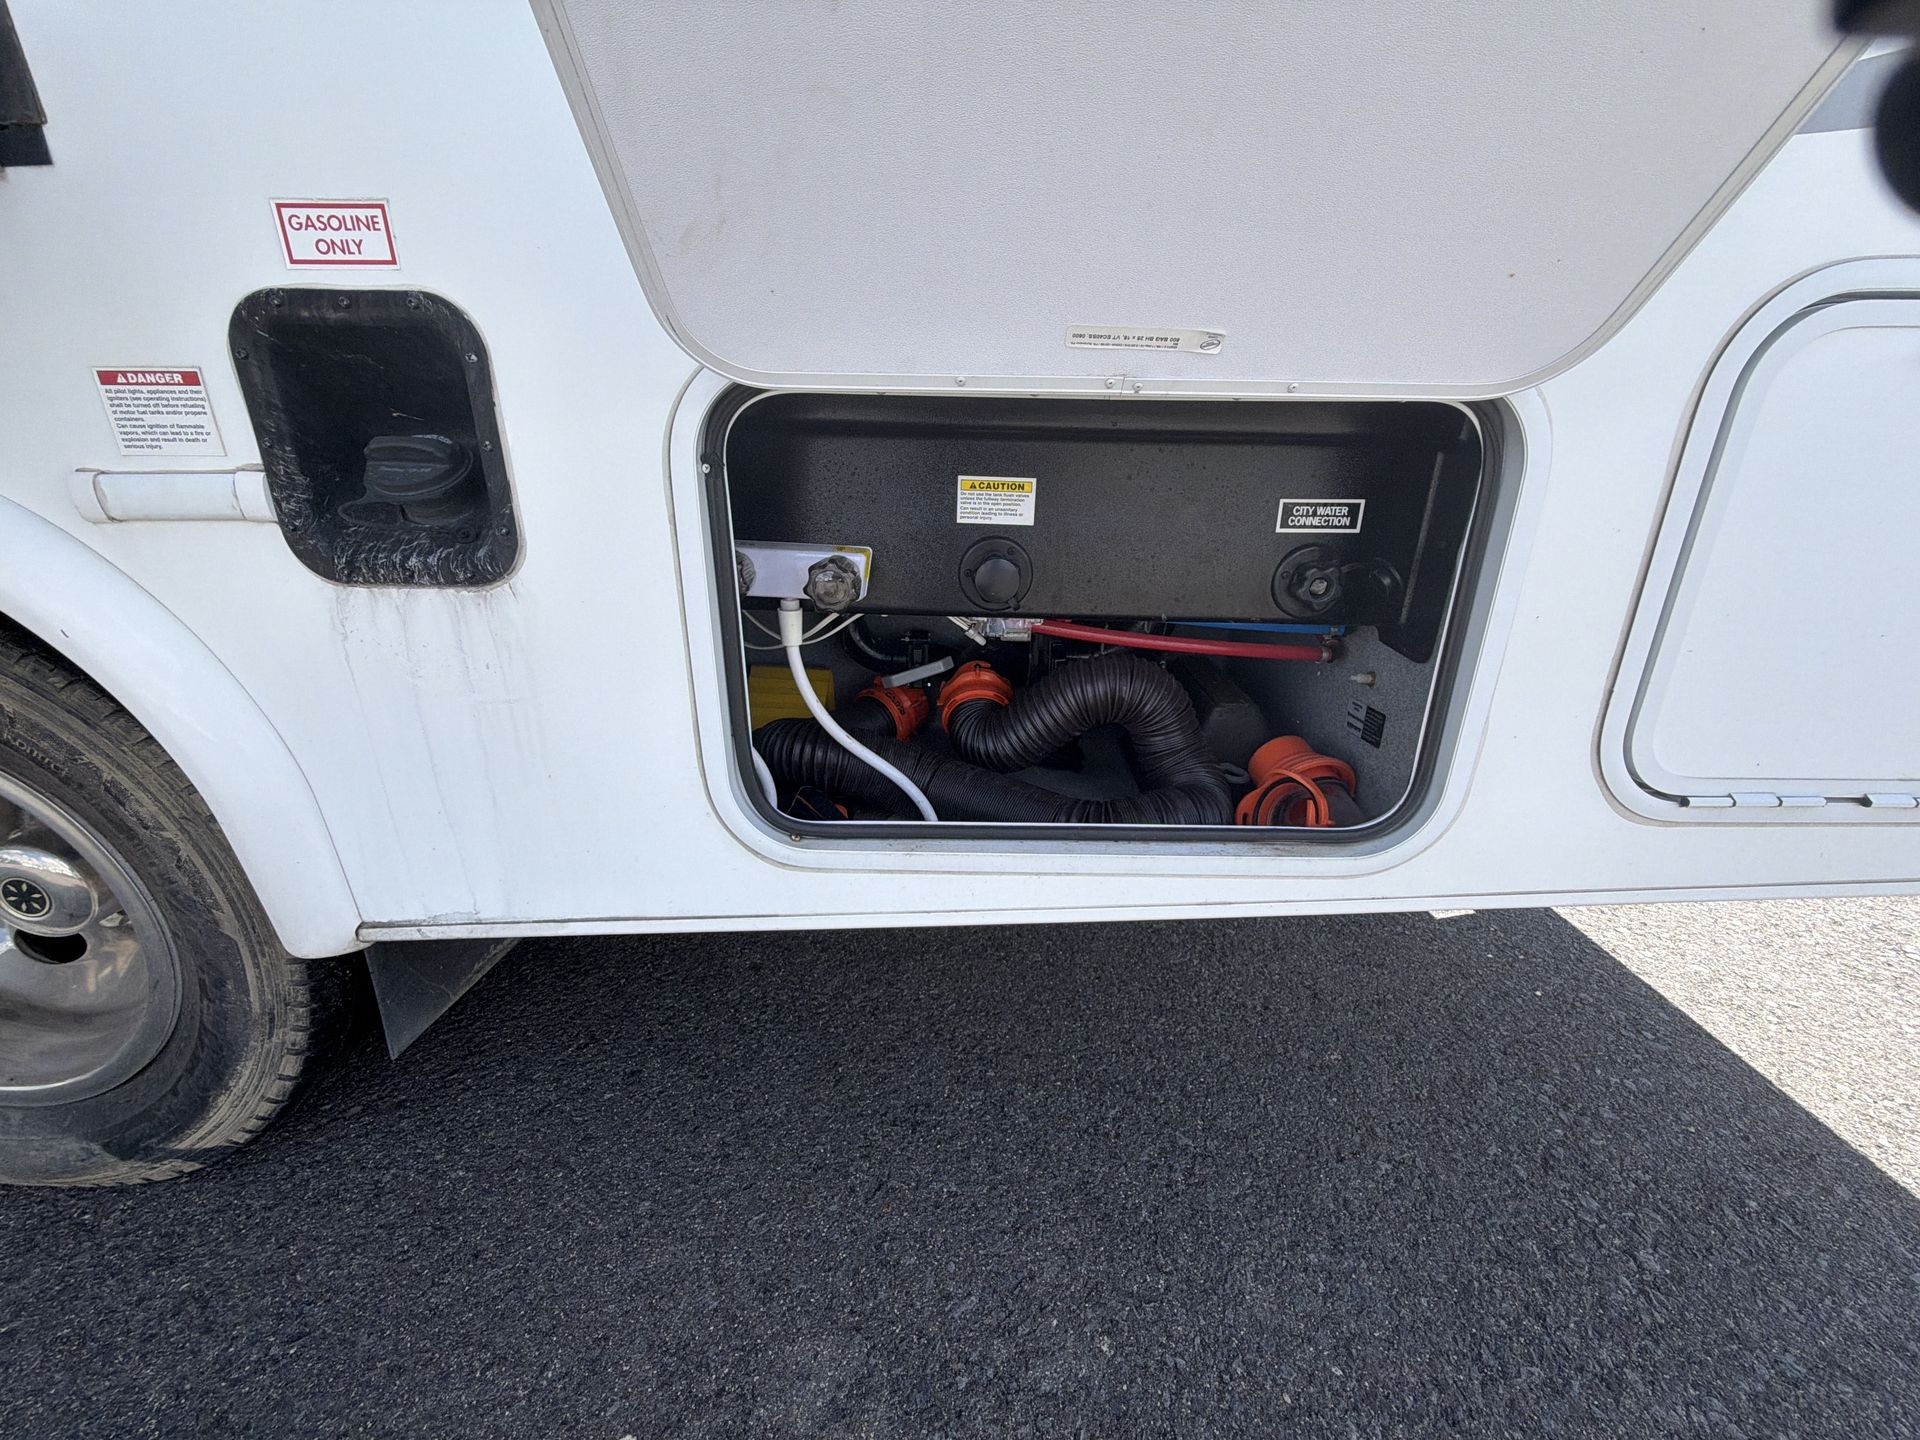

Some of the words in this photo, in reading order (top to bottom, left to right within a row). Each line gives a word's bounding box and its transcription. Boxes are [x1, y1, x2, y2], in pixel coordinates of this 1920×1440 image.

[288, 214, 381, 232] GASOLINE
[315, 238, 363, 255] ONLY
[128, 373, 183, 384] DANGER
[978, 482, 1024, 490] CAUTION
[1293, 506, 1315, 516] CITY
[1316, 506, 1348, 516] WATER
[1288, 516, 1350, 526] CONNECTION
